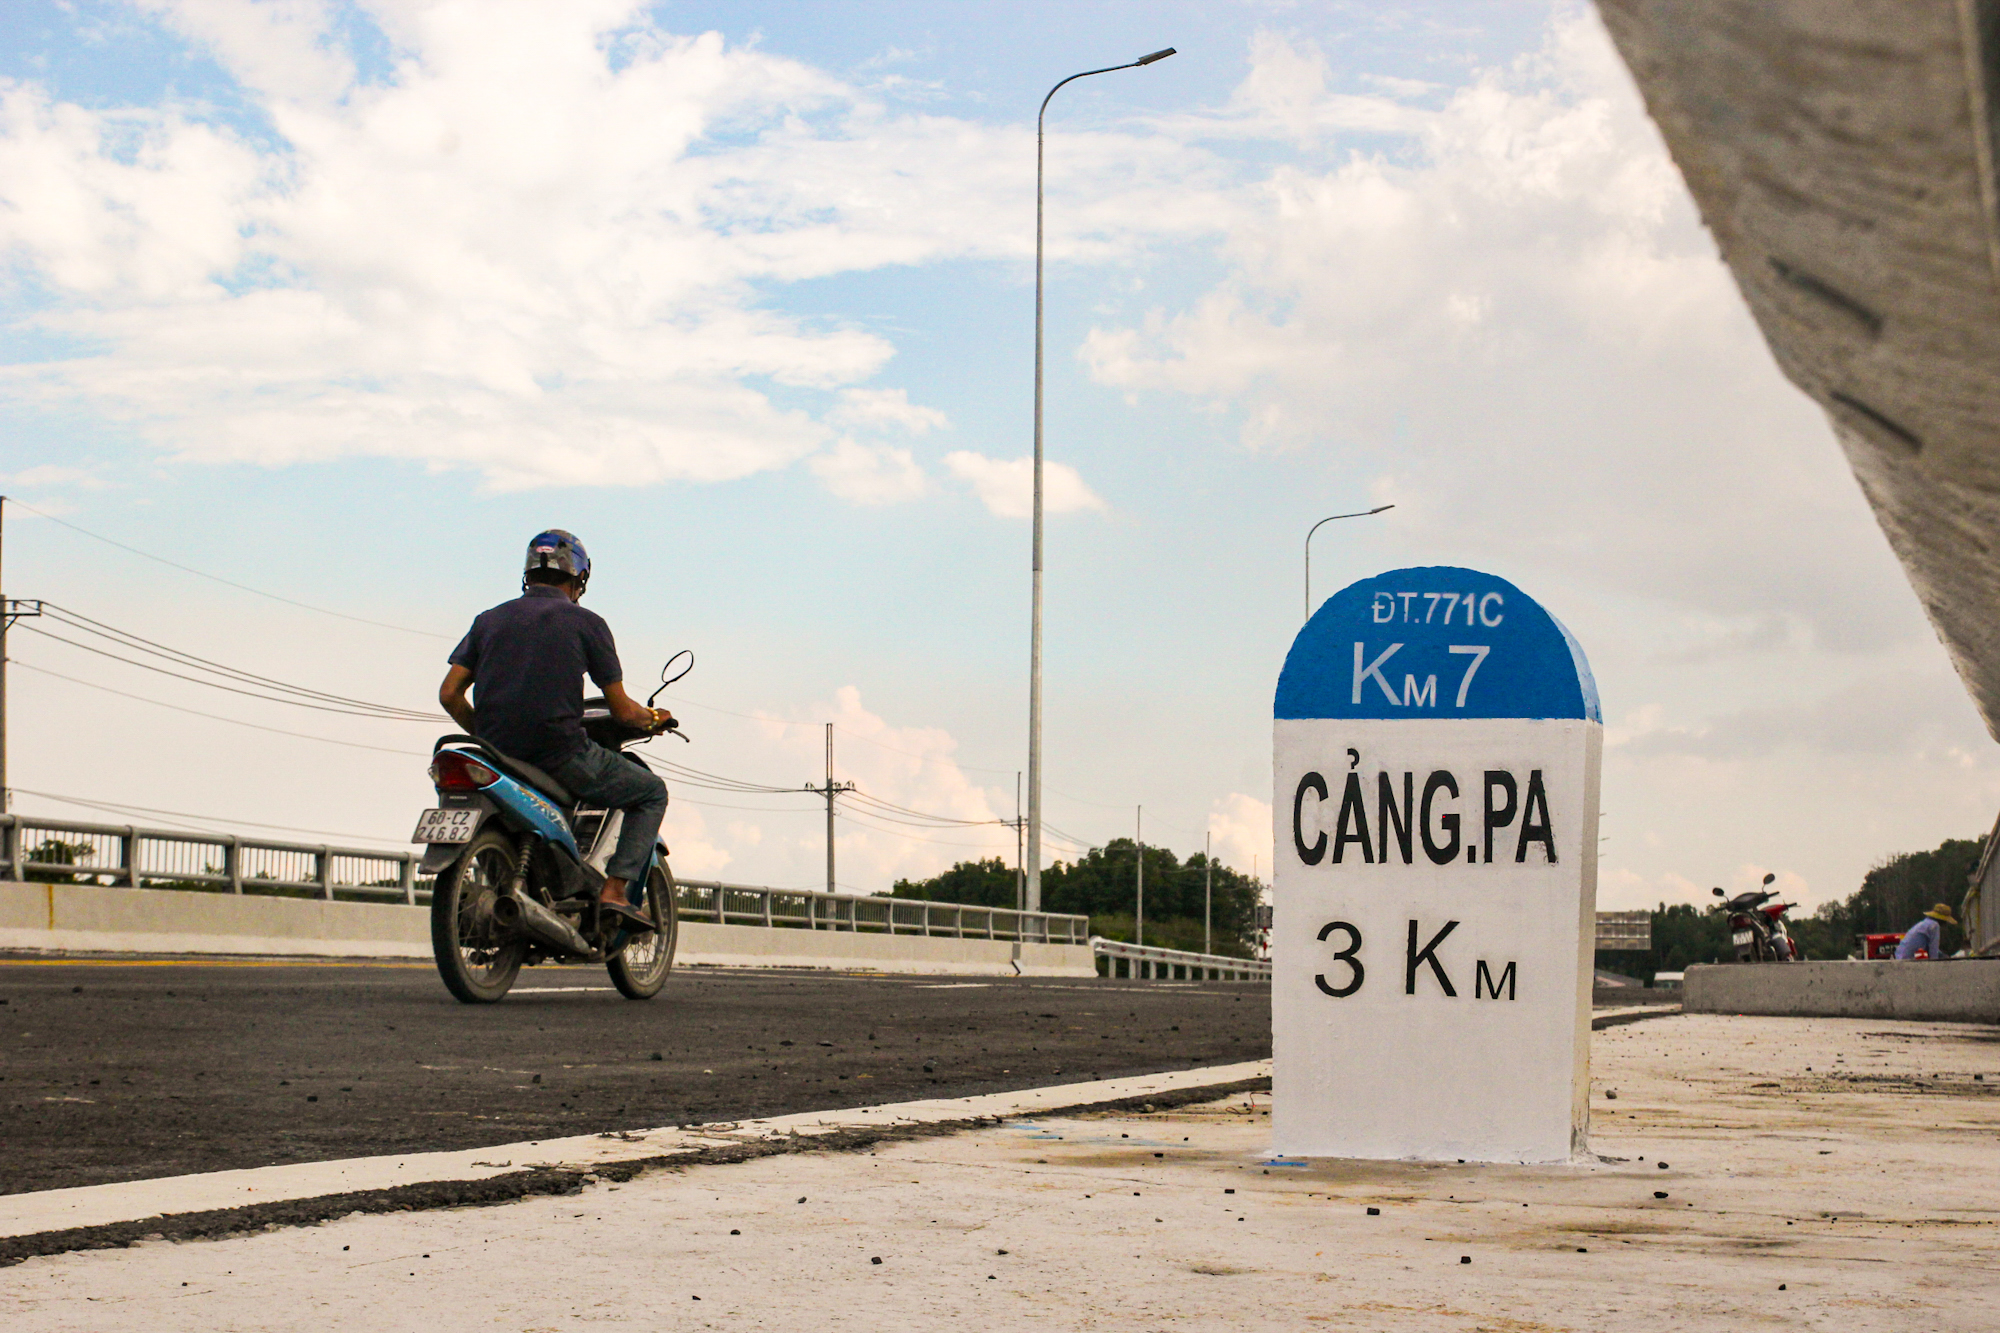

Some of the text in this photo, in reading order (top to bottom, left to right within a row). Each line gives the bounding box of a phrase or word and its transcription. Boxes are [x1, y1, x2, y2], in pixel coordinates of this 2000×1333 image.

[1371, 592, 1504, 627] ĐT.771C
[1448, 645, 1491, 708] 7
[1293, 748, 1557, 865] CẢNG.PA
[1314, 920, 1365, 998] 3
